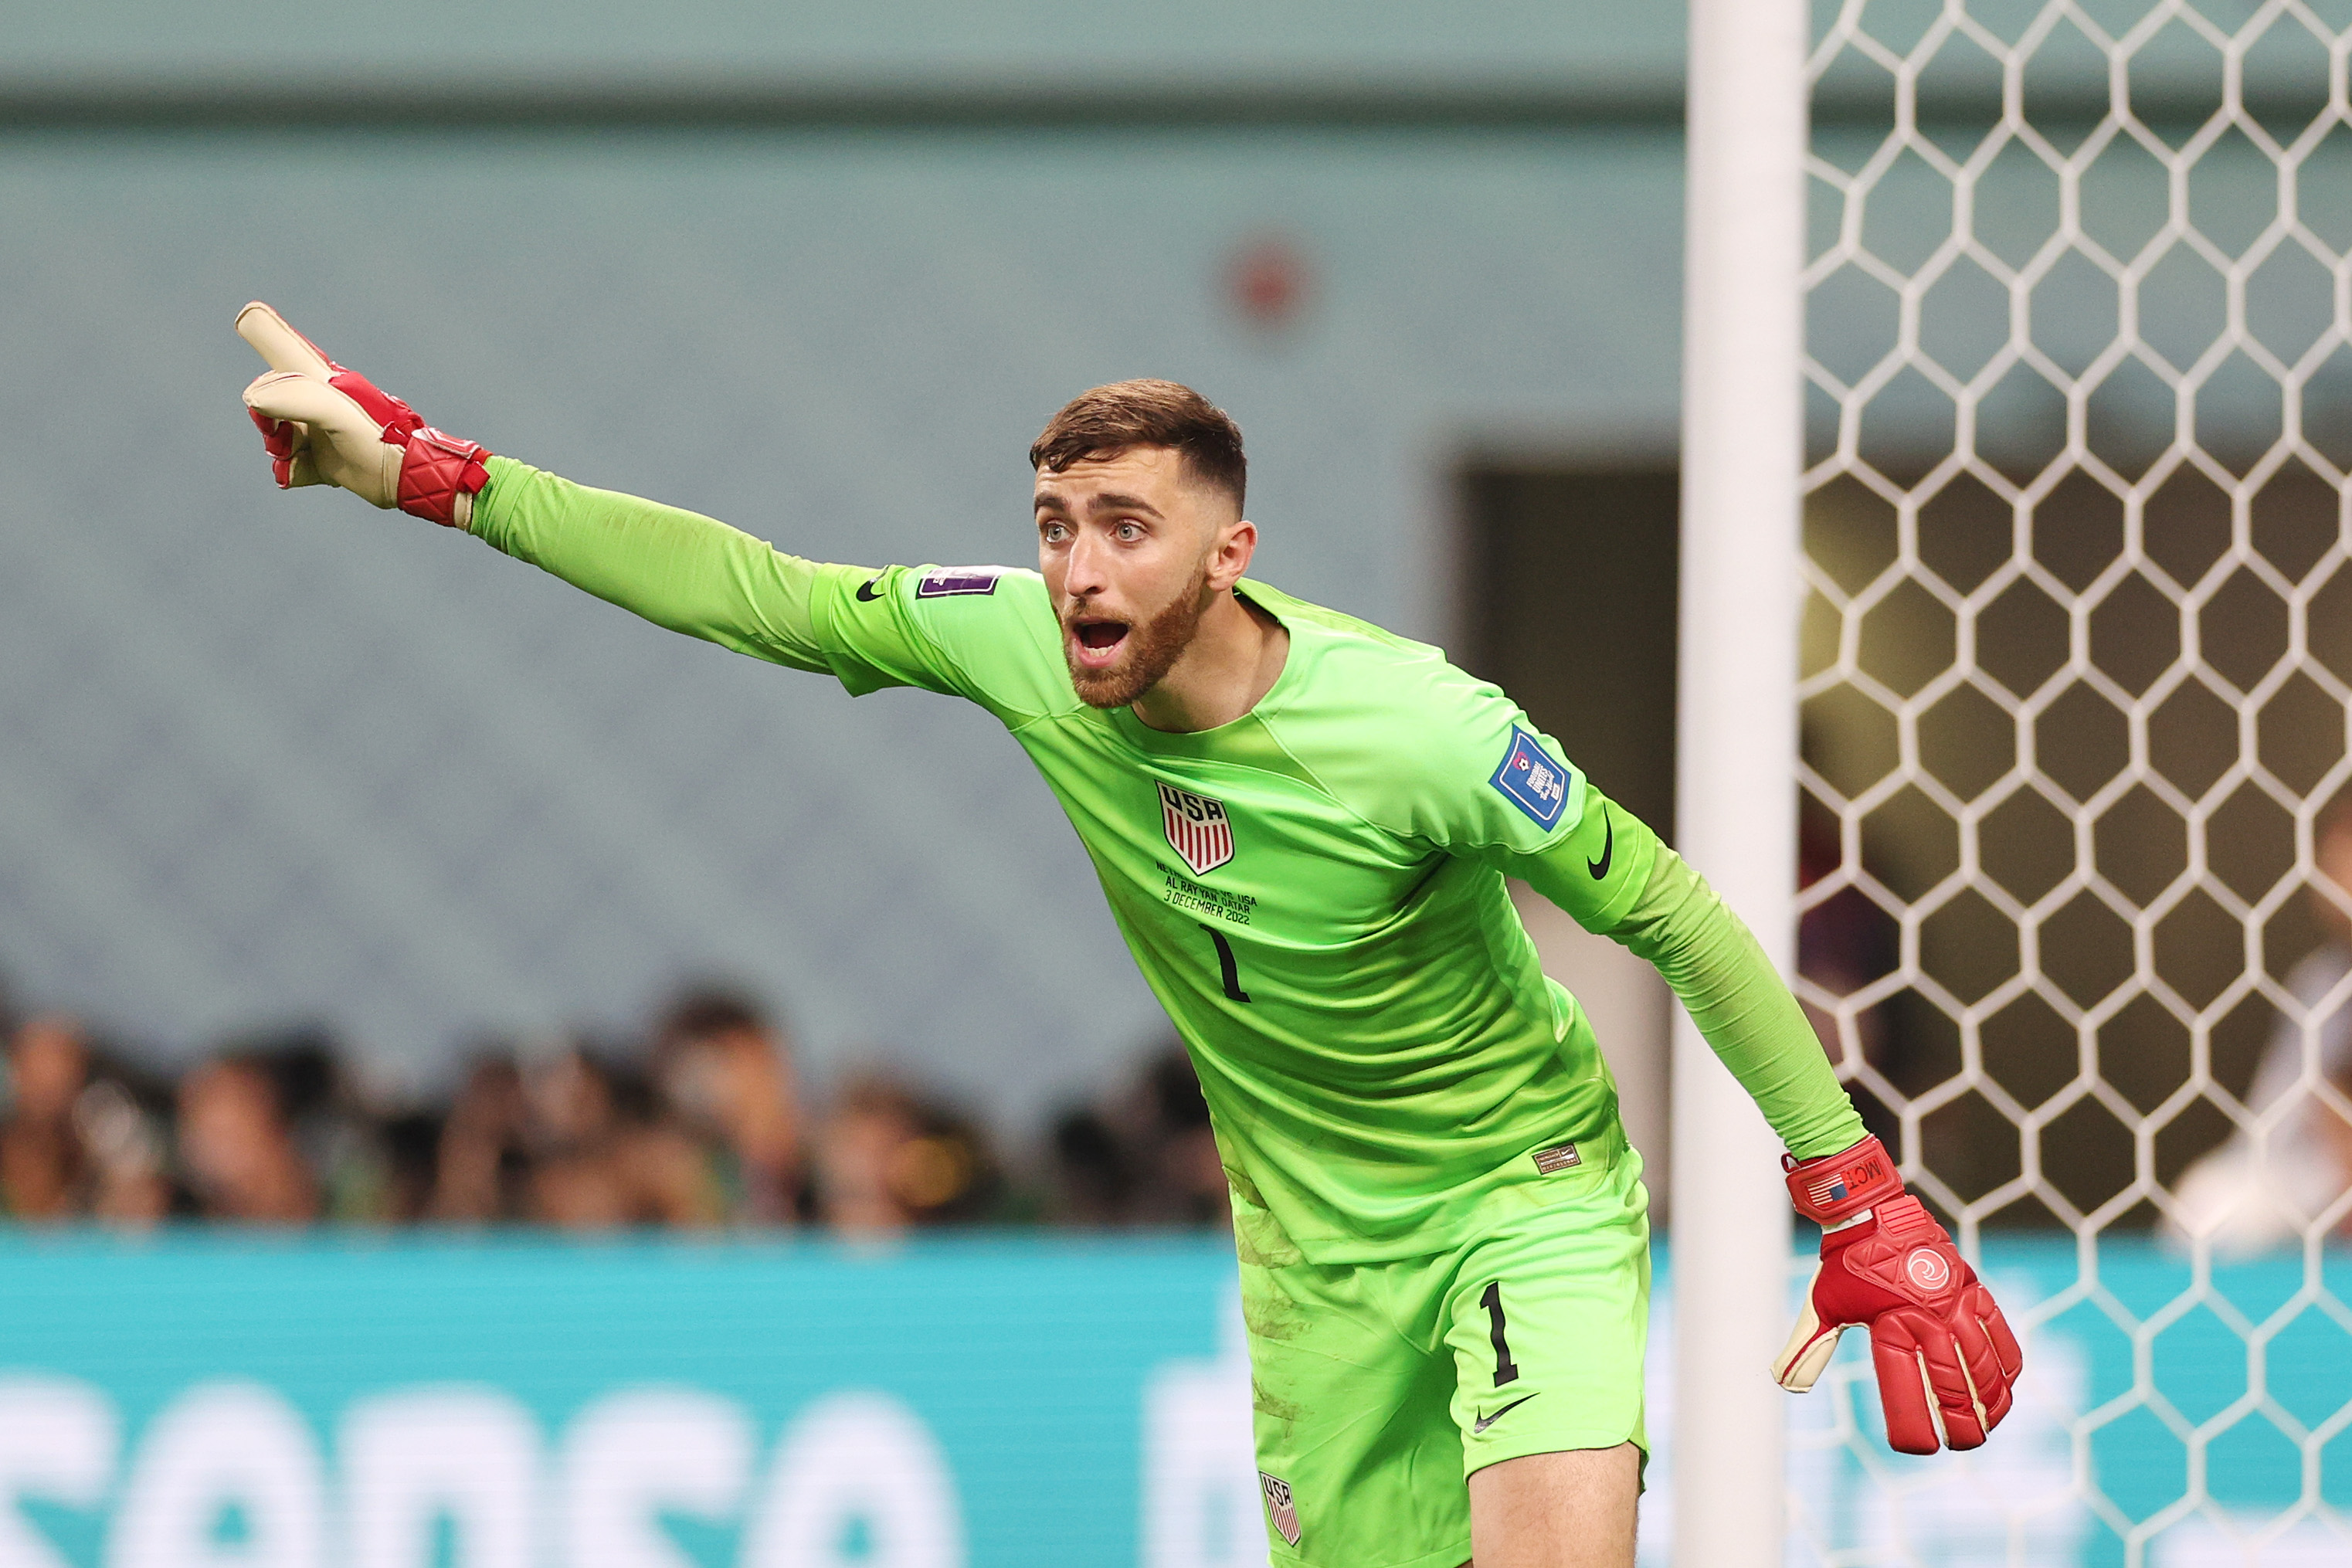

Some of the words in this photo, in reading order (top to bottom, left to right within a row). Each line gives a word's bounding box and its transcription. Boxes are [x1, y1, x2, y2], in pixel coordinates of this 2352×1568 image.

[1162, 786, 1223, 822] USA
[1164, 889, 1172, 902] 3
[1172, 892, 1224, 918] DECEMBER
[1226, 909, 1250, 925] 2022
[1166, 875, 1178, 889] AL
[1221, 897, 1251, 915] QATAR
[1238, 894, 1257, 907] USA
[1198, 923, 1251, 1003] 1
[1479, 1280, 1519, 1388] 1
[1263, 1476, 1291, 1507] USA
